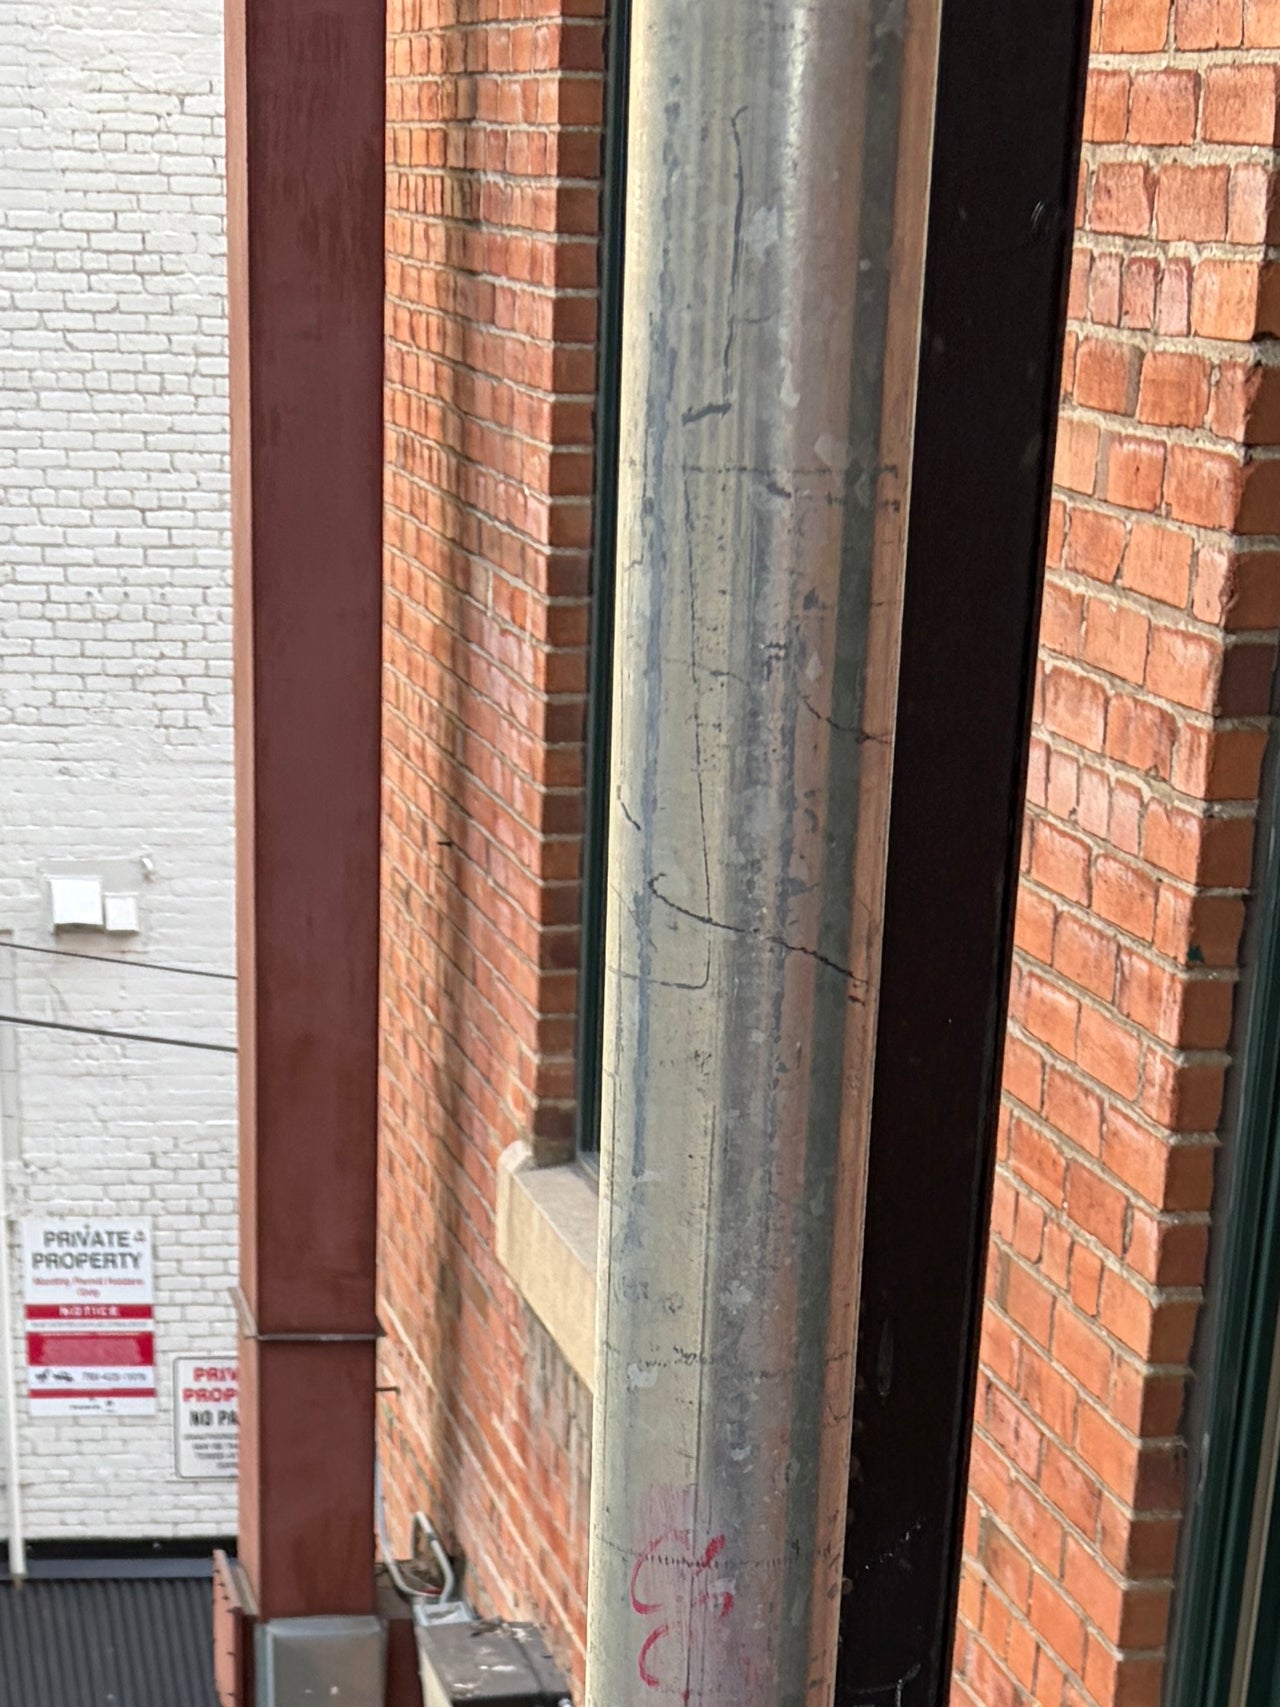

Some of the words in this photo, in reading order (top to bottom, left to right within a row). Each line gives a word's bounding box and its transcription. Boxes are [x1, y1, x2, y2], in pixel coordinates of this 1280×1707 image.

[43, 1230, 131, 1248] PRIVATE
[31, 1251, 143, 1270] PROPERTY
[193, 1366, 238, 1382] PRIV
[182, 1387, 237, 1402] PROP
[189, 1409, 214, 1426] NO
